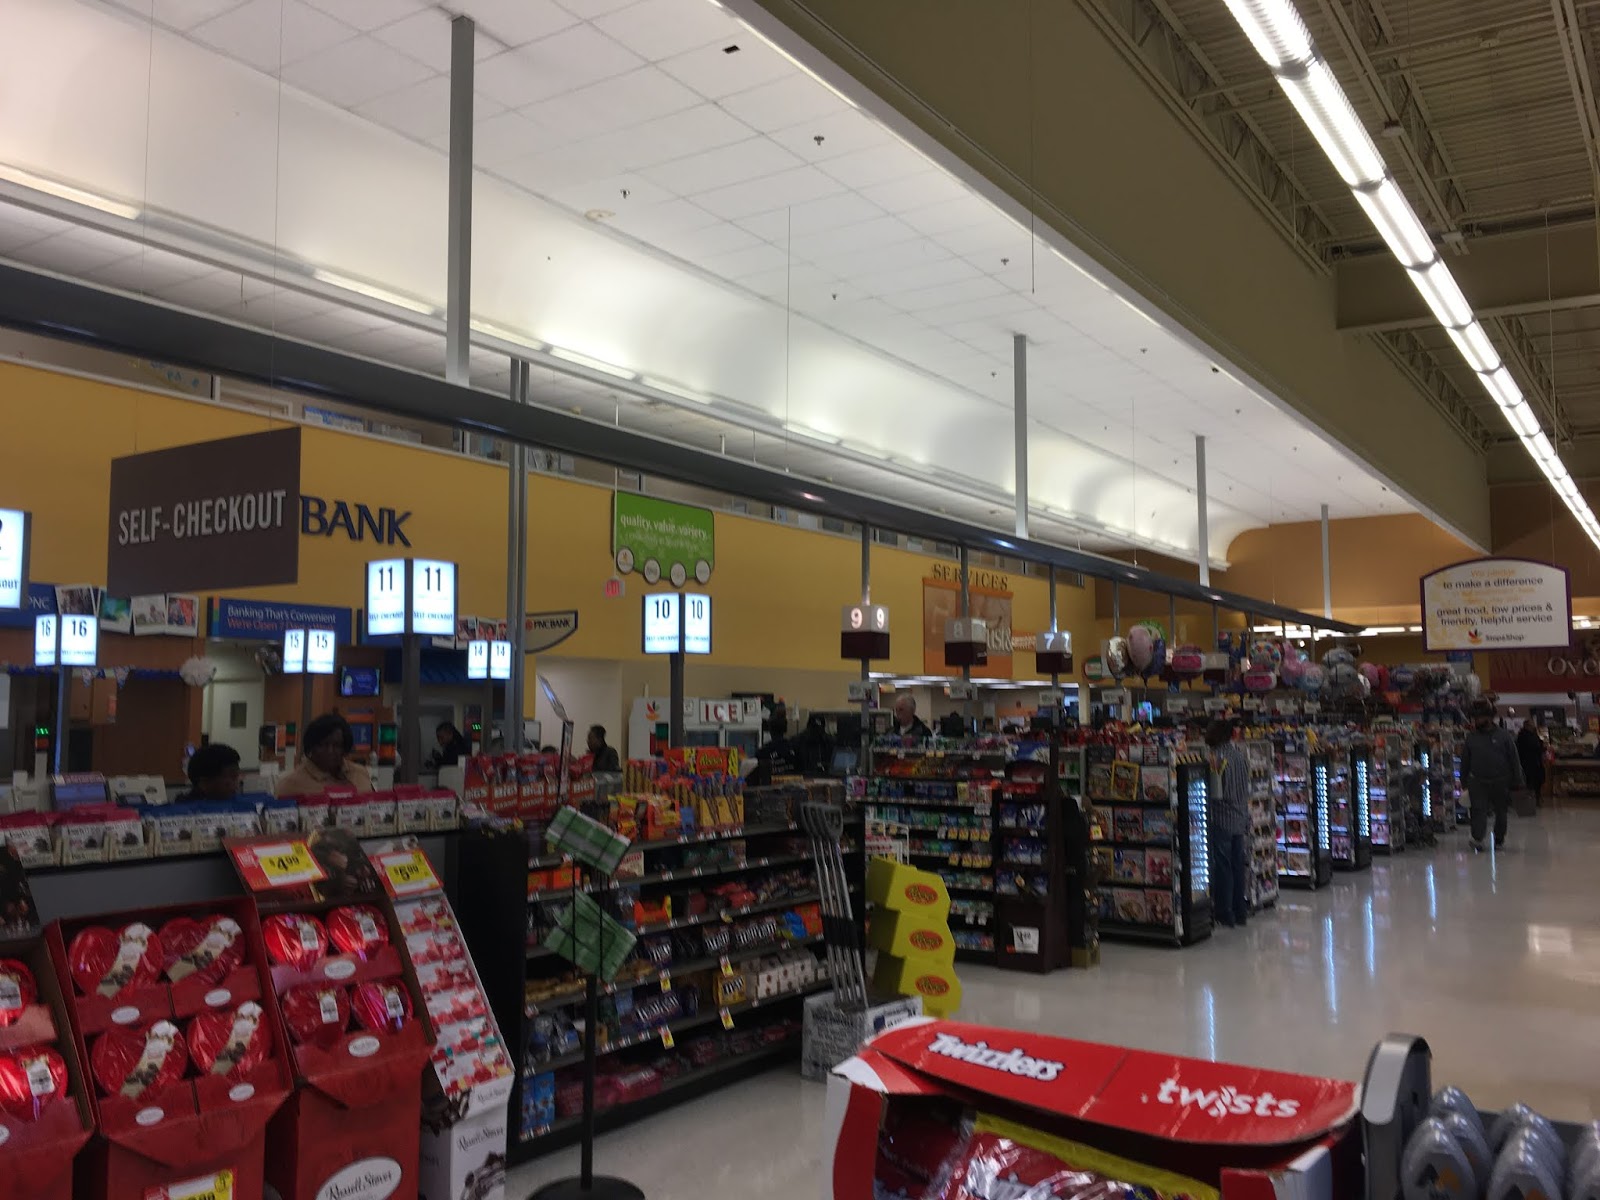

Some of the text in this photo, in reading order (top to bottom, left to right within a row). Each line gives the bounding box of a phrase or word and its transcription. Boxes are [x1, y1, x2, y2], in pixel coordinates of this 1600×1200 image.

[118, 488, 287, 546] SELF-CHECKOUT
[299, 493, 412, 548] BANK
[378, 565, 393, 592] 11
[424, 565, 442, 592] 11
[1442, 576, 1544, 590] to make a difference
[227, 604, 337, 624] Banking That's Convenient
[654, 599, 671, 619] 10
[690, 599, 703, 620] 10
[850, 606, 863, 630] 9
[876, 606, 885, 630] 9
[1436, 602, 1554, 618] great food, low prices &
[41, 619, 52, 638] 16
[72, 619, 88, 638] 16
[549, 618, 572, 629] BANK
[1440, 614, 1554, 627] friendly, helpful service
[290, 633, 299, 649] 15
[316, 633, 328, 649] 15
[1043, 631, 1055, 650] 7
[704, 702, 739, 723] ICE
[928, 1032, 1065, 1082] Twizzlers
[1156, 1076, 1301, 1119] twists
